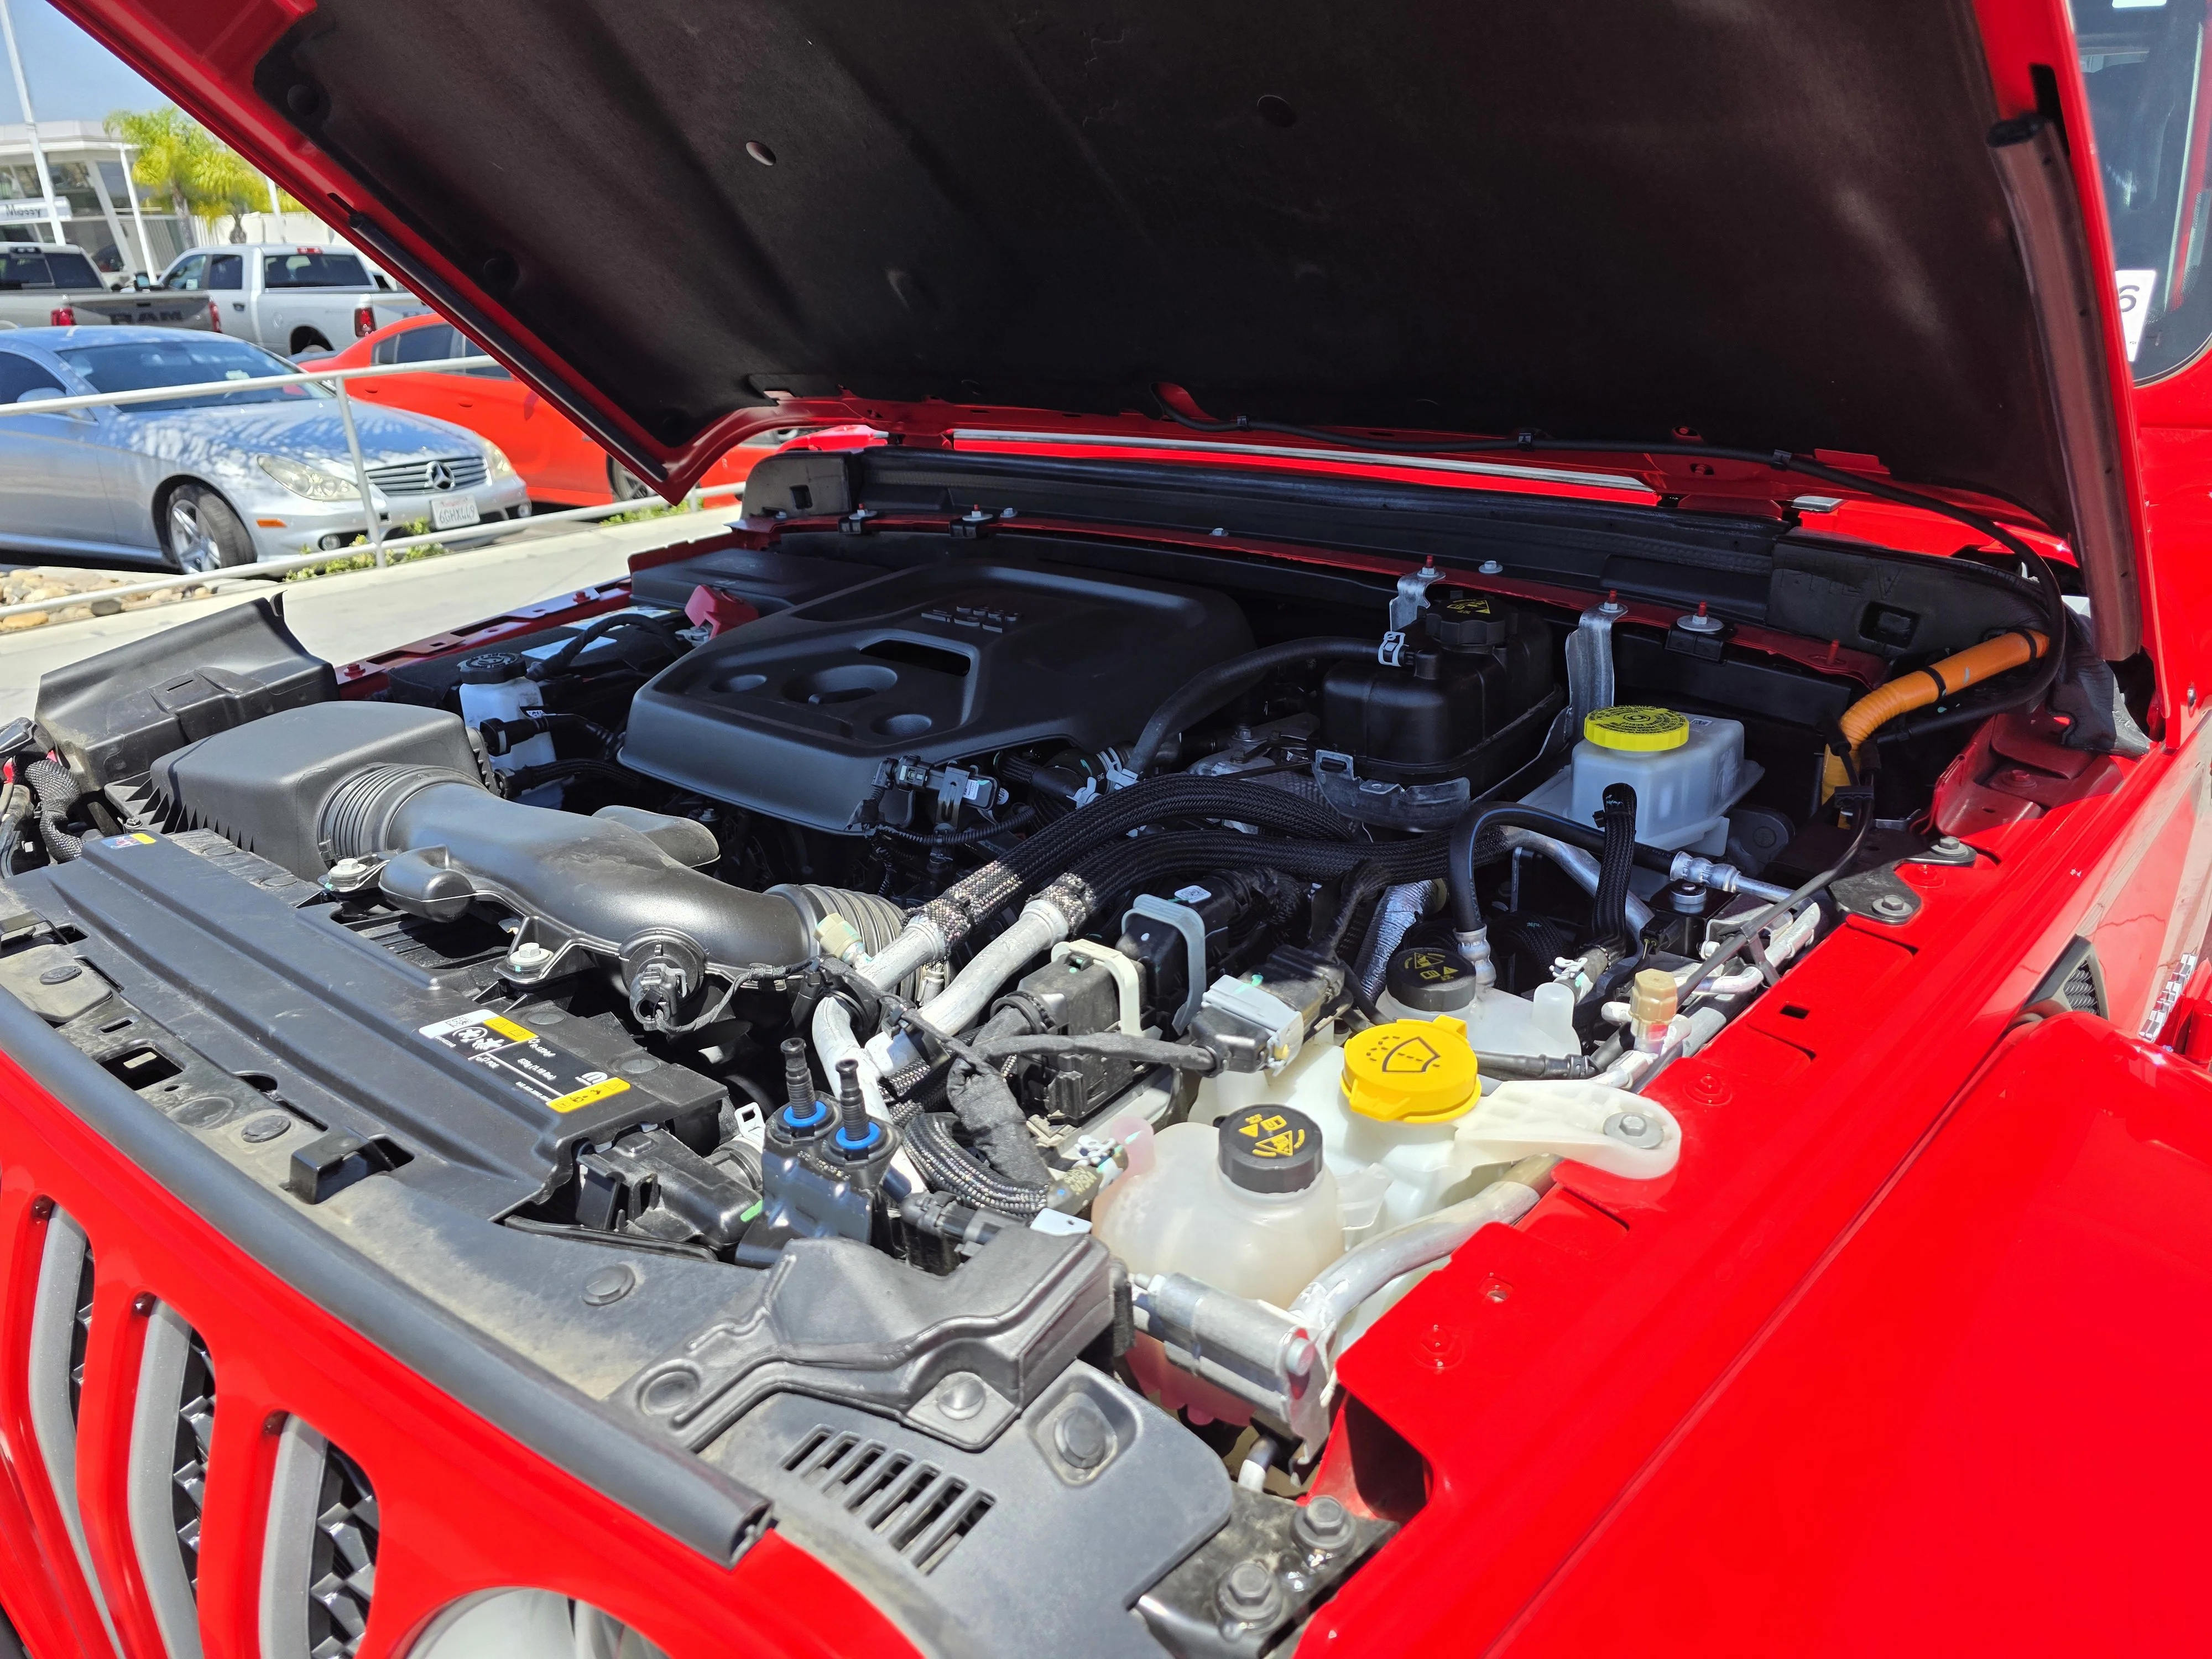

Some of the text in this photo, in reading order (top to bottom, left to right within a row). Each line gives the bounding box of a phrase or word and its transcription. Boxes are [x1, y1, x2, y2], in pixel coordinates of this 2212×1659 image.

[4, 204, 41, 218] Mossy
[2119, 284, 2140, 313] 6
[109, 310, 184, 325] RAM
[440, 505, 475, 523] 6GHX449
[1469, 881, 1482, 922] GALAXY
